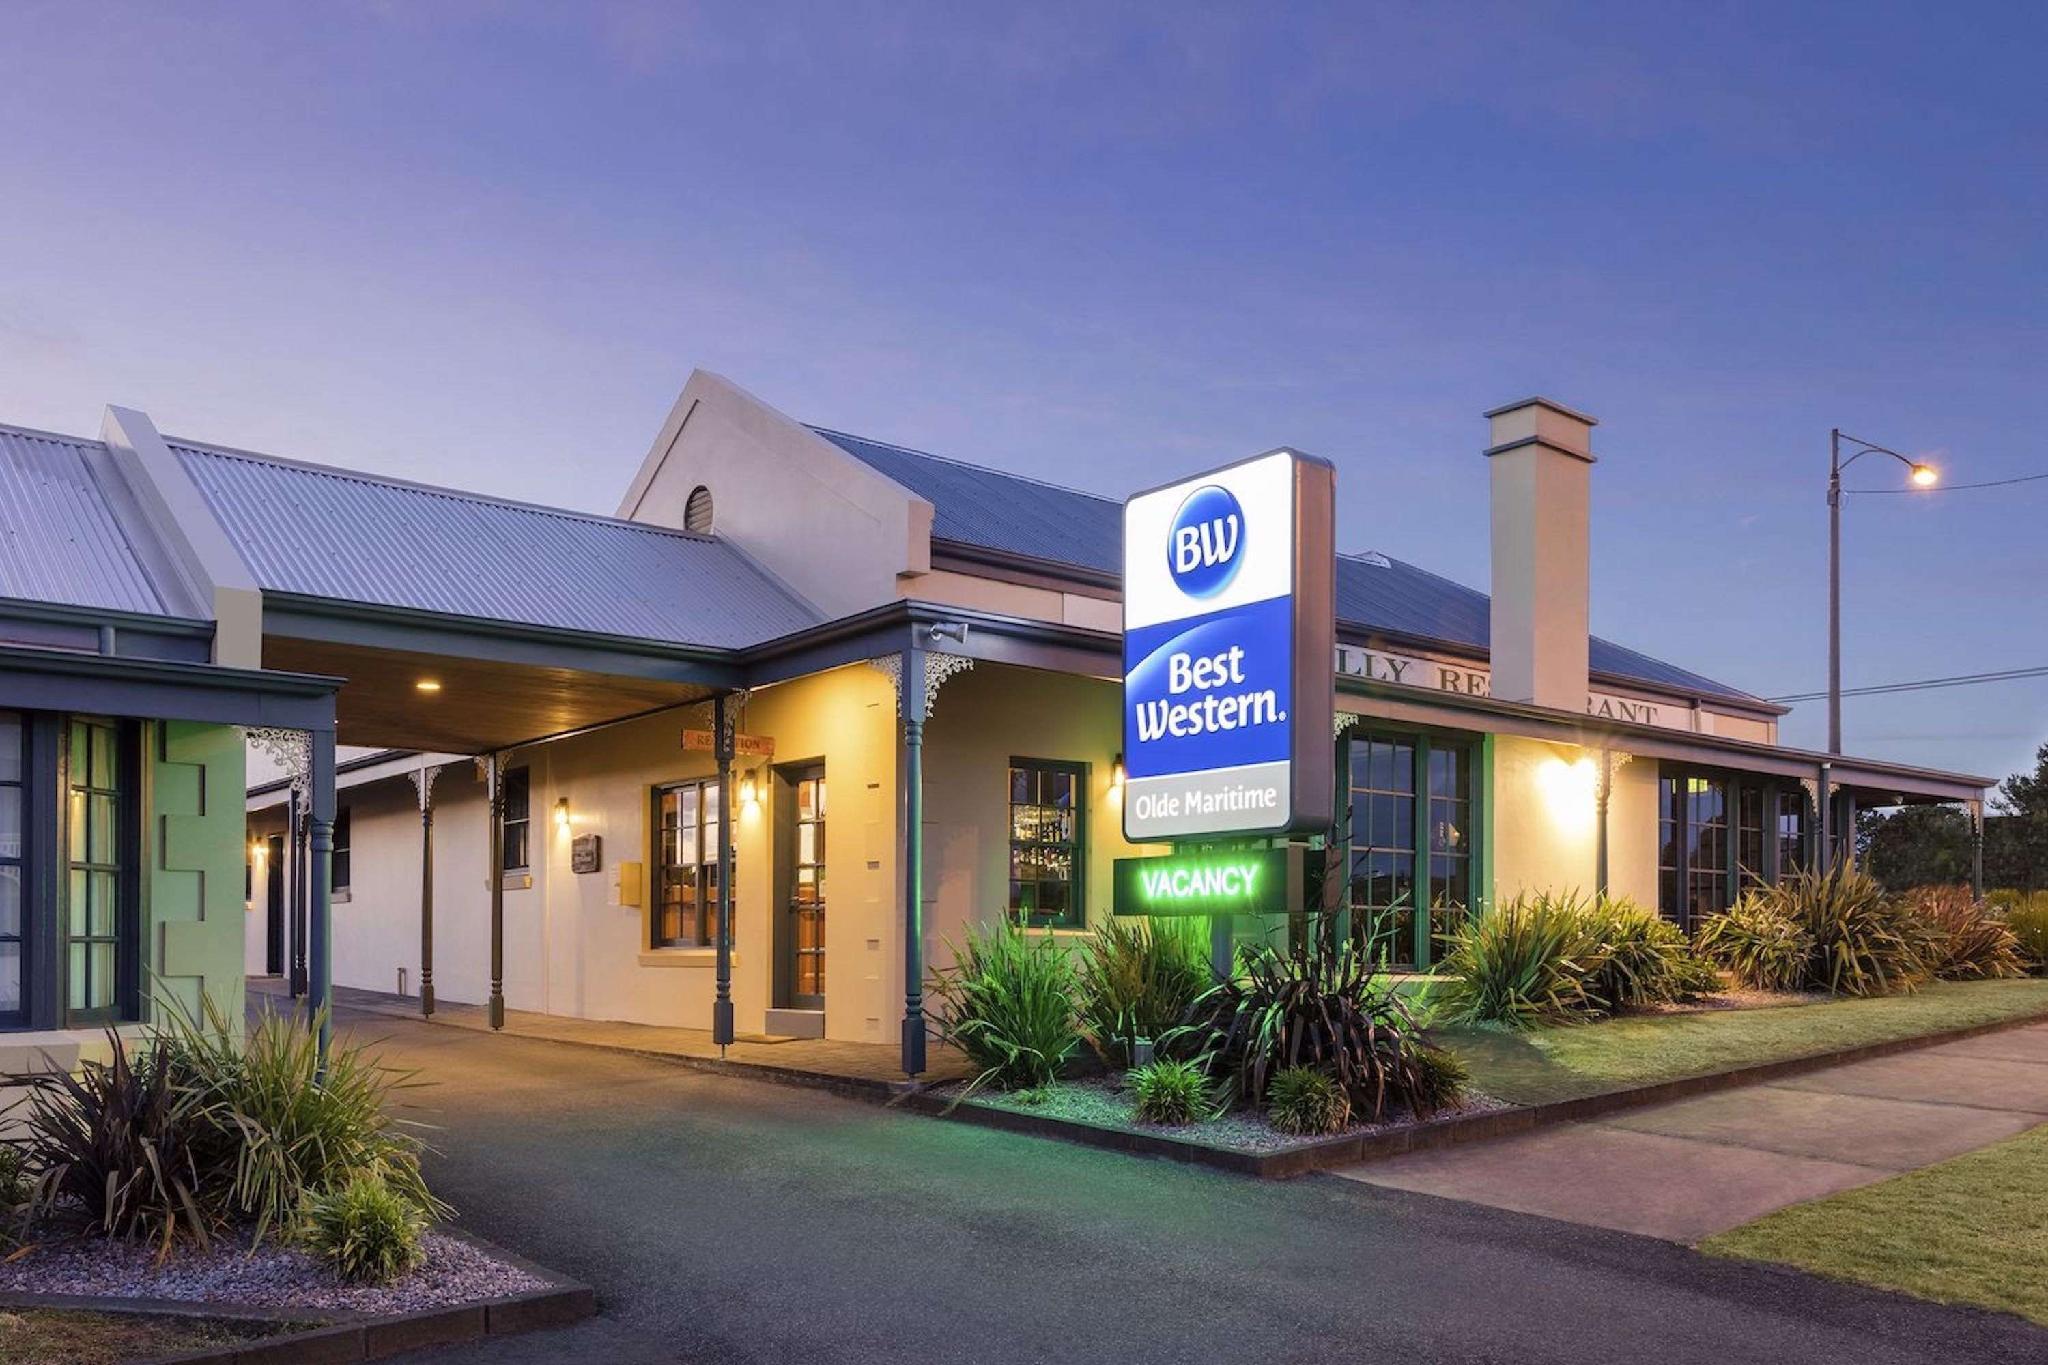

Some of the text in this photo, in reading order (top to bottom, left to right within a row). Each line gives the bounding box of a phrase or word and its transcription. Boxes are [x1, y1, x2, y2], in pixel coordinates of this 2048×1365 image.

[1176, 514, 1239, 574] BW
[1169, 645, 1245, 695] Best
[1336, 648, 1411, 682] LLY
[1136, 785, 1278, 820] Olde Maritime
[1140, 864, 1259, 897] VACANCY
